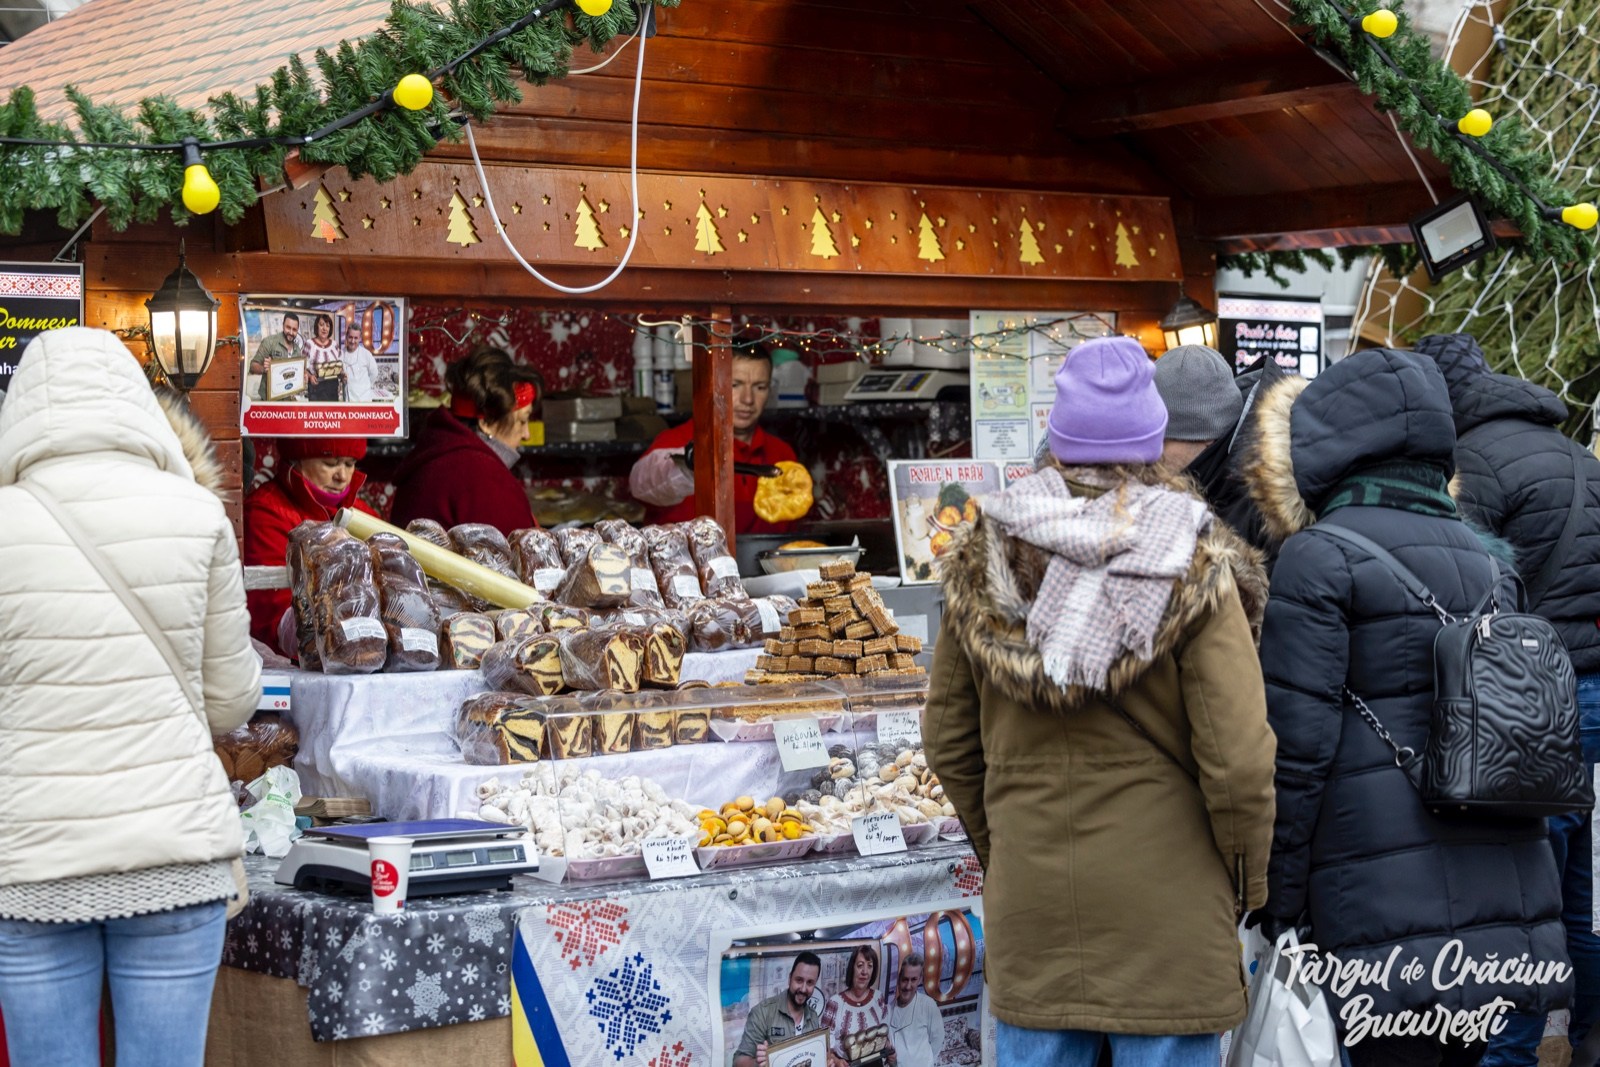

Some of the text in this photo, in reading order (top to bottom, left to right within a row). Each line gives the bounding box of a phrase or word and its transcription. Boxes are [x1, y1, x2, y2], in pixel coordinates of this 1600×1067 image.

[250, 410, 394, 420] COZONACUL DE AUR VATRA DOMNEASCĂ
